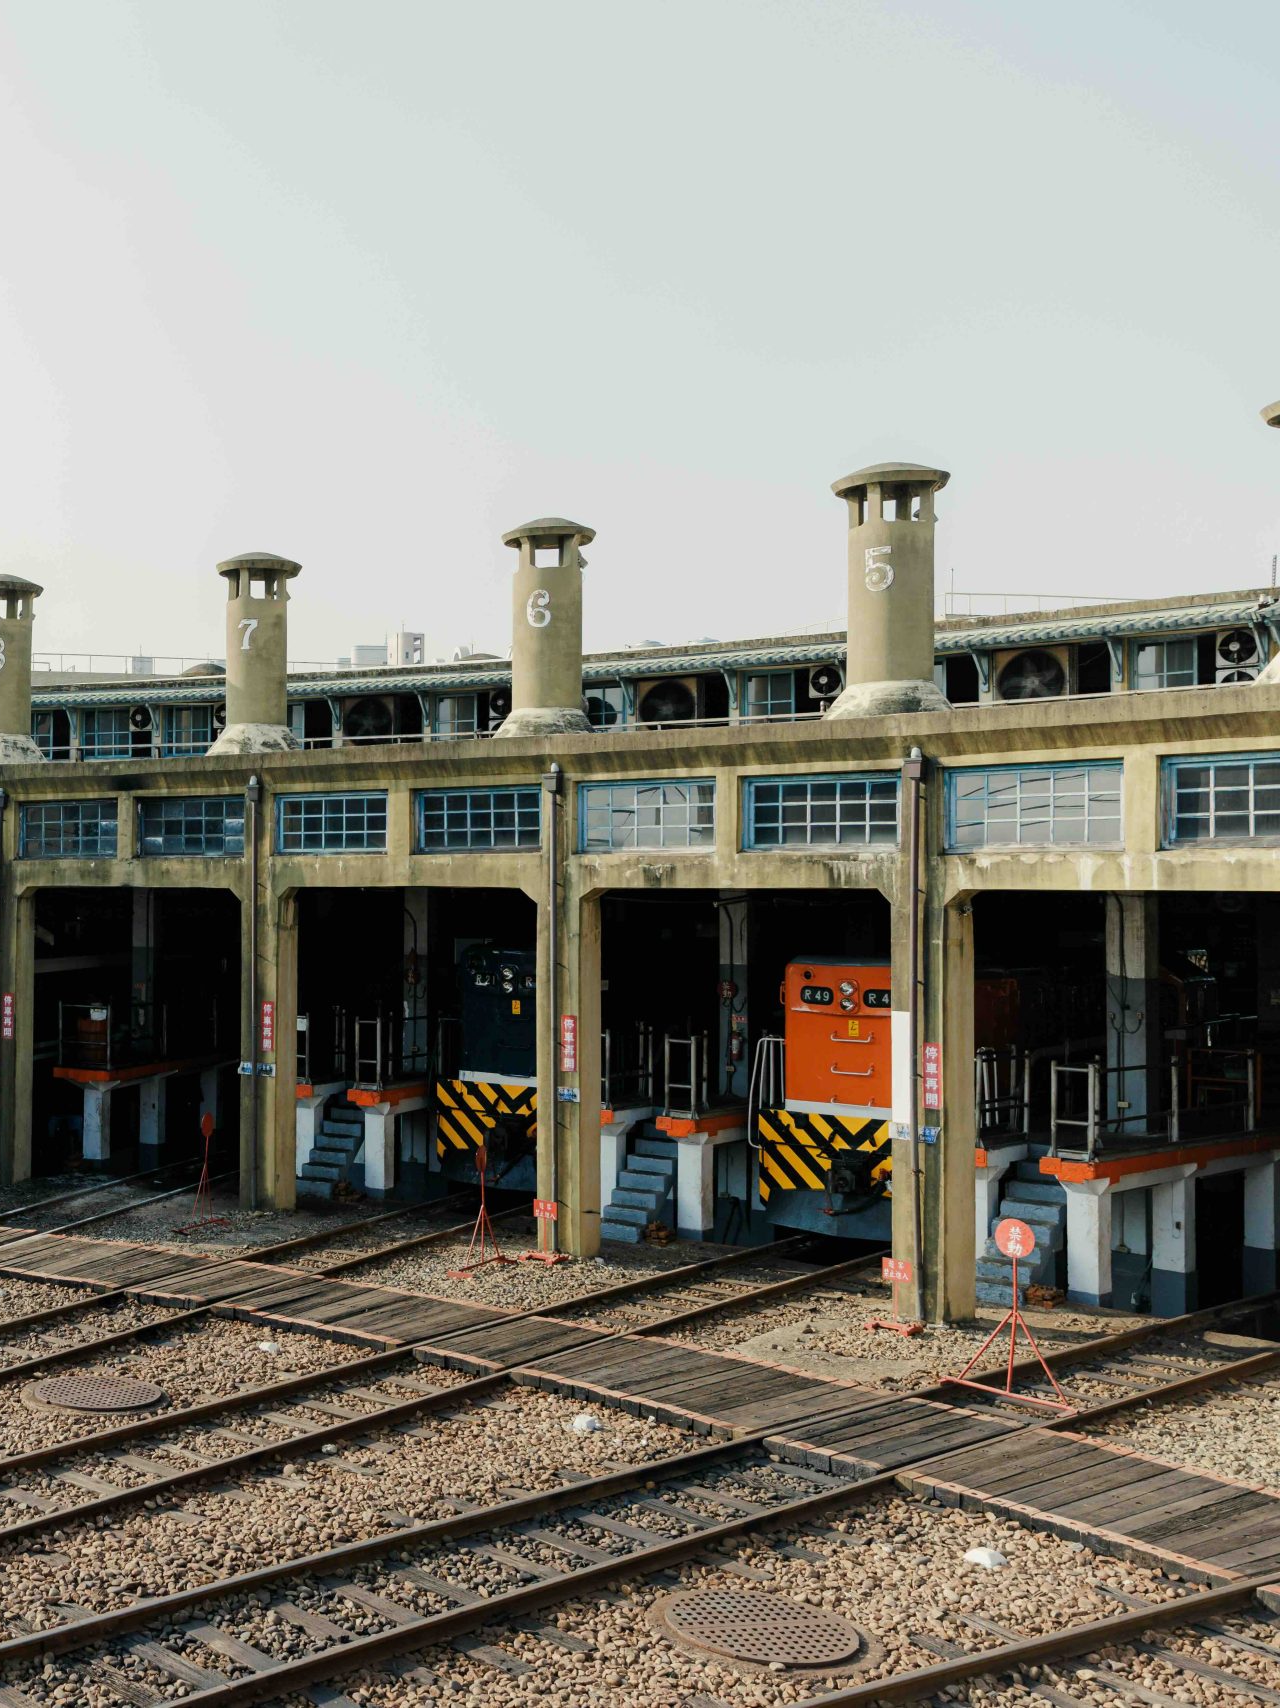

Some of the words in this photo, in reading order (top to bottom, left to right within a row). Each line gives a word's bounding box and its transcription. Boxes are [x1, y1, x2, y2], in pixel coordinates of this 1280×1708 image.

[865, 546, 894, 592] 5
[526, 589, 551, 628] 6
[238, 619, 259, 650] 7
[476, 974, 483, 985] R
[525, 976, 533, 986] R
[804, 989, 812, 1002] R
[815, 989, 830, 1002] 49
[868, 995, 876, 1004] R
[263, 1003, 273, 1050] 停車再開
[563, 1018, 575, 1070] 停車再開
[924, 1046, 938, 1106] 停車再開
[1006, 1226, 1022, 1257] 禁動
